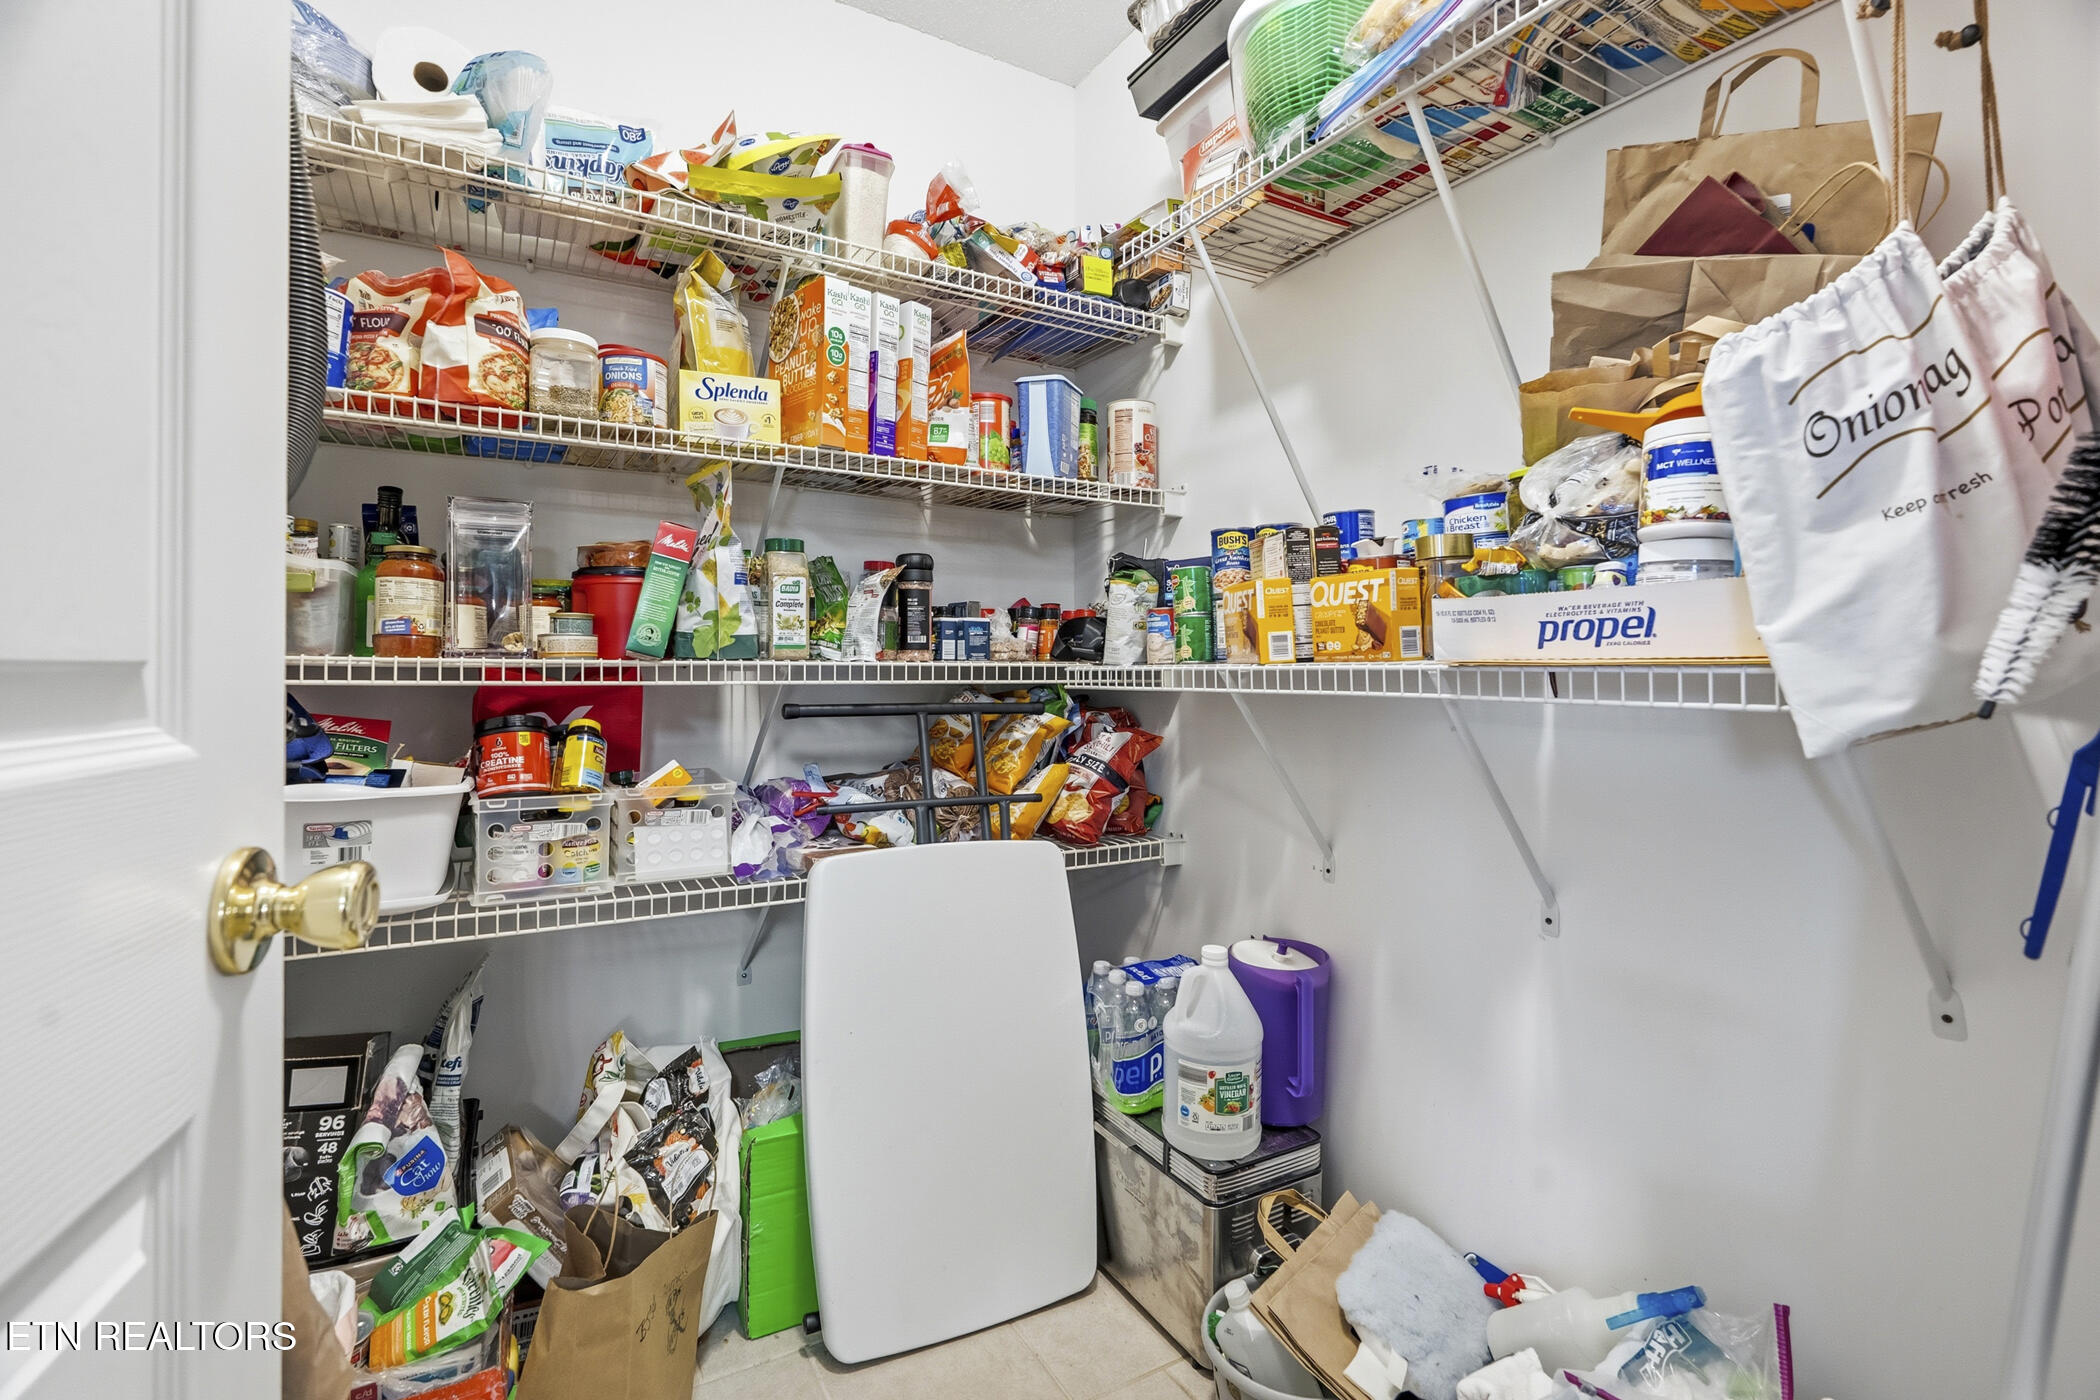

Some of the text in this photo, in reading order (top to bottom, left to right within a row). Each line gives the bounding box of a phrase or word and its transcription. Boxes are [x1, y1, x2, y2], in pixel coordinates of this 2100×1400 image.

[622, 130, 643, 142] 280
[827, 288, 848, 301] Kashi
[850, 292, 871, 306] Kashi
[854, 302, 866, 311] GO
[879, 300, 899, 313] Kashi
[883, 309, 895, 318] GO
[913, 308, 930, 321] Kashi
[800, 317, 817, 340] up
[774, 351, 808, 378] PEANUT
[605, 371, 643, 381] ONIONS
[782, 361, 817, 387] BUTTER
[695, 377, 769, 402] Splenda
[1656, 460, 1675, 470] MCT
[1881, 496, 1927, 522] Keep
[1449, 515, 1487, 525] Chicken
[1449, 521, 1481, 533] Breast
[1217, 534, 1248, 546] BUSH'S
[1310, 577, 1385, 608] QUEST
[775, 600, 804, 609] Complete
[1223, 588, 1254, 614] QUEST
[1583, 601, 1622, 610] BEVERAGE
[1545, 609, 1597, 618] ELECTROLYTES
[1606, 606, 1642, 614] VITAMINS
[1537, 606, 1651, 650] propel
[317, 717, 366, 734] Melitta
[335, 742, 378, 753] FILTERS
[480, 755, 525, 769] CREATINE
[1085, 758, 1106, 773] SIZE
[1219, 1088, 1247, 1099] VINEGAR
[319, 1114, 346, 1131] 96
[315, 1130, 345, 1138] SERVINGS
[317, 1141, 338, 1154] 48
[402, 1150, 426, 1172] PURINA
[400, 1158, 431, 1187] Cat
[413, 1162, 441, 1188] Chow
